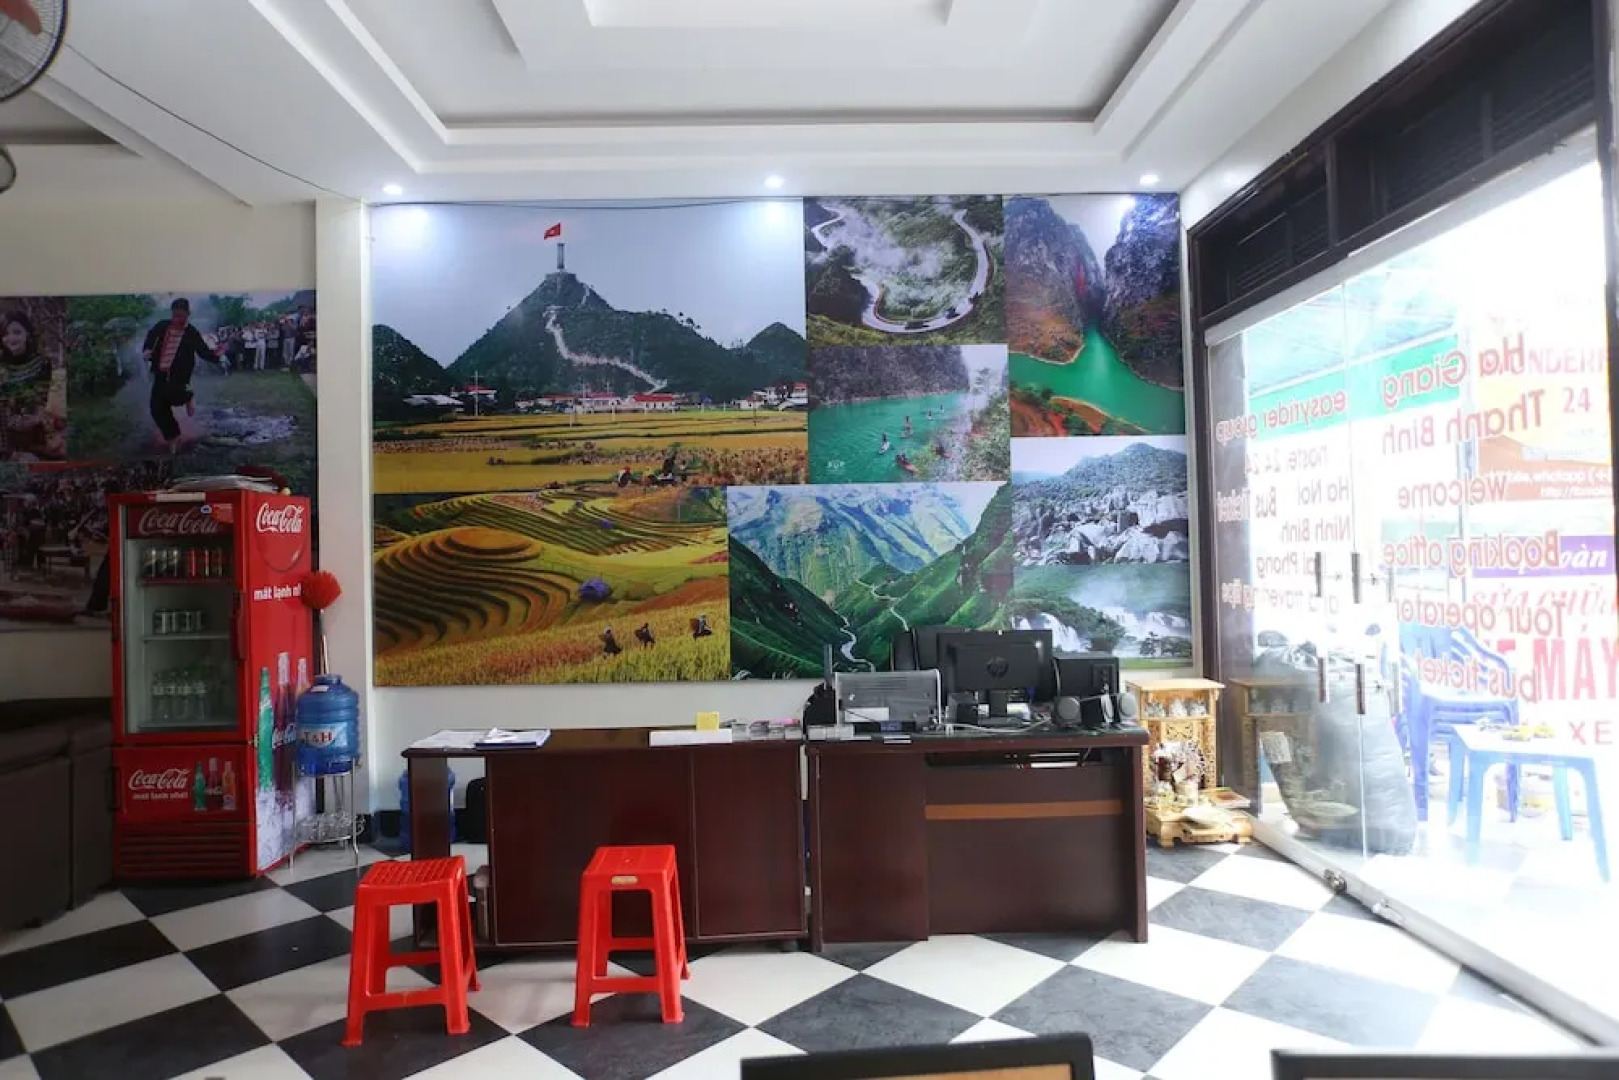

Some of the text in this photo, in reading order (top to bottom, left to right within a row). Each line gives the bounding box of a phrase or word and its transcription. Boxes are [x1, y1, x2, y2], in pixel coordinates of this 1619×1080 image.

[139, 506, 220, 535] Coca-Cola
[256, 502, 304, 533] Coca-Cola
[1568, 719, 1613, 745] XE
[129, 768, 191, 791] Coca-Cola
